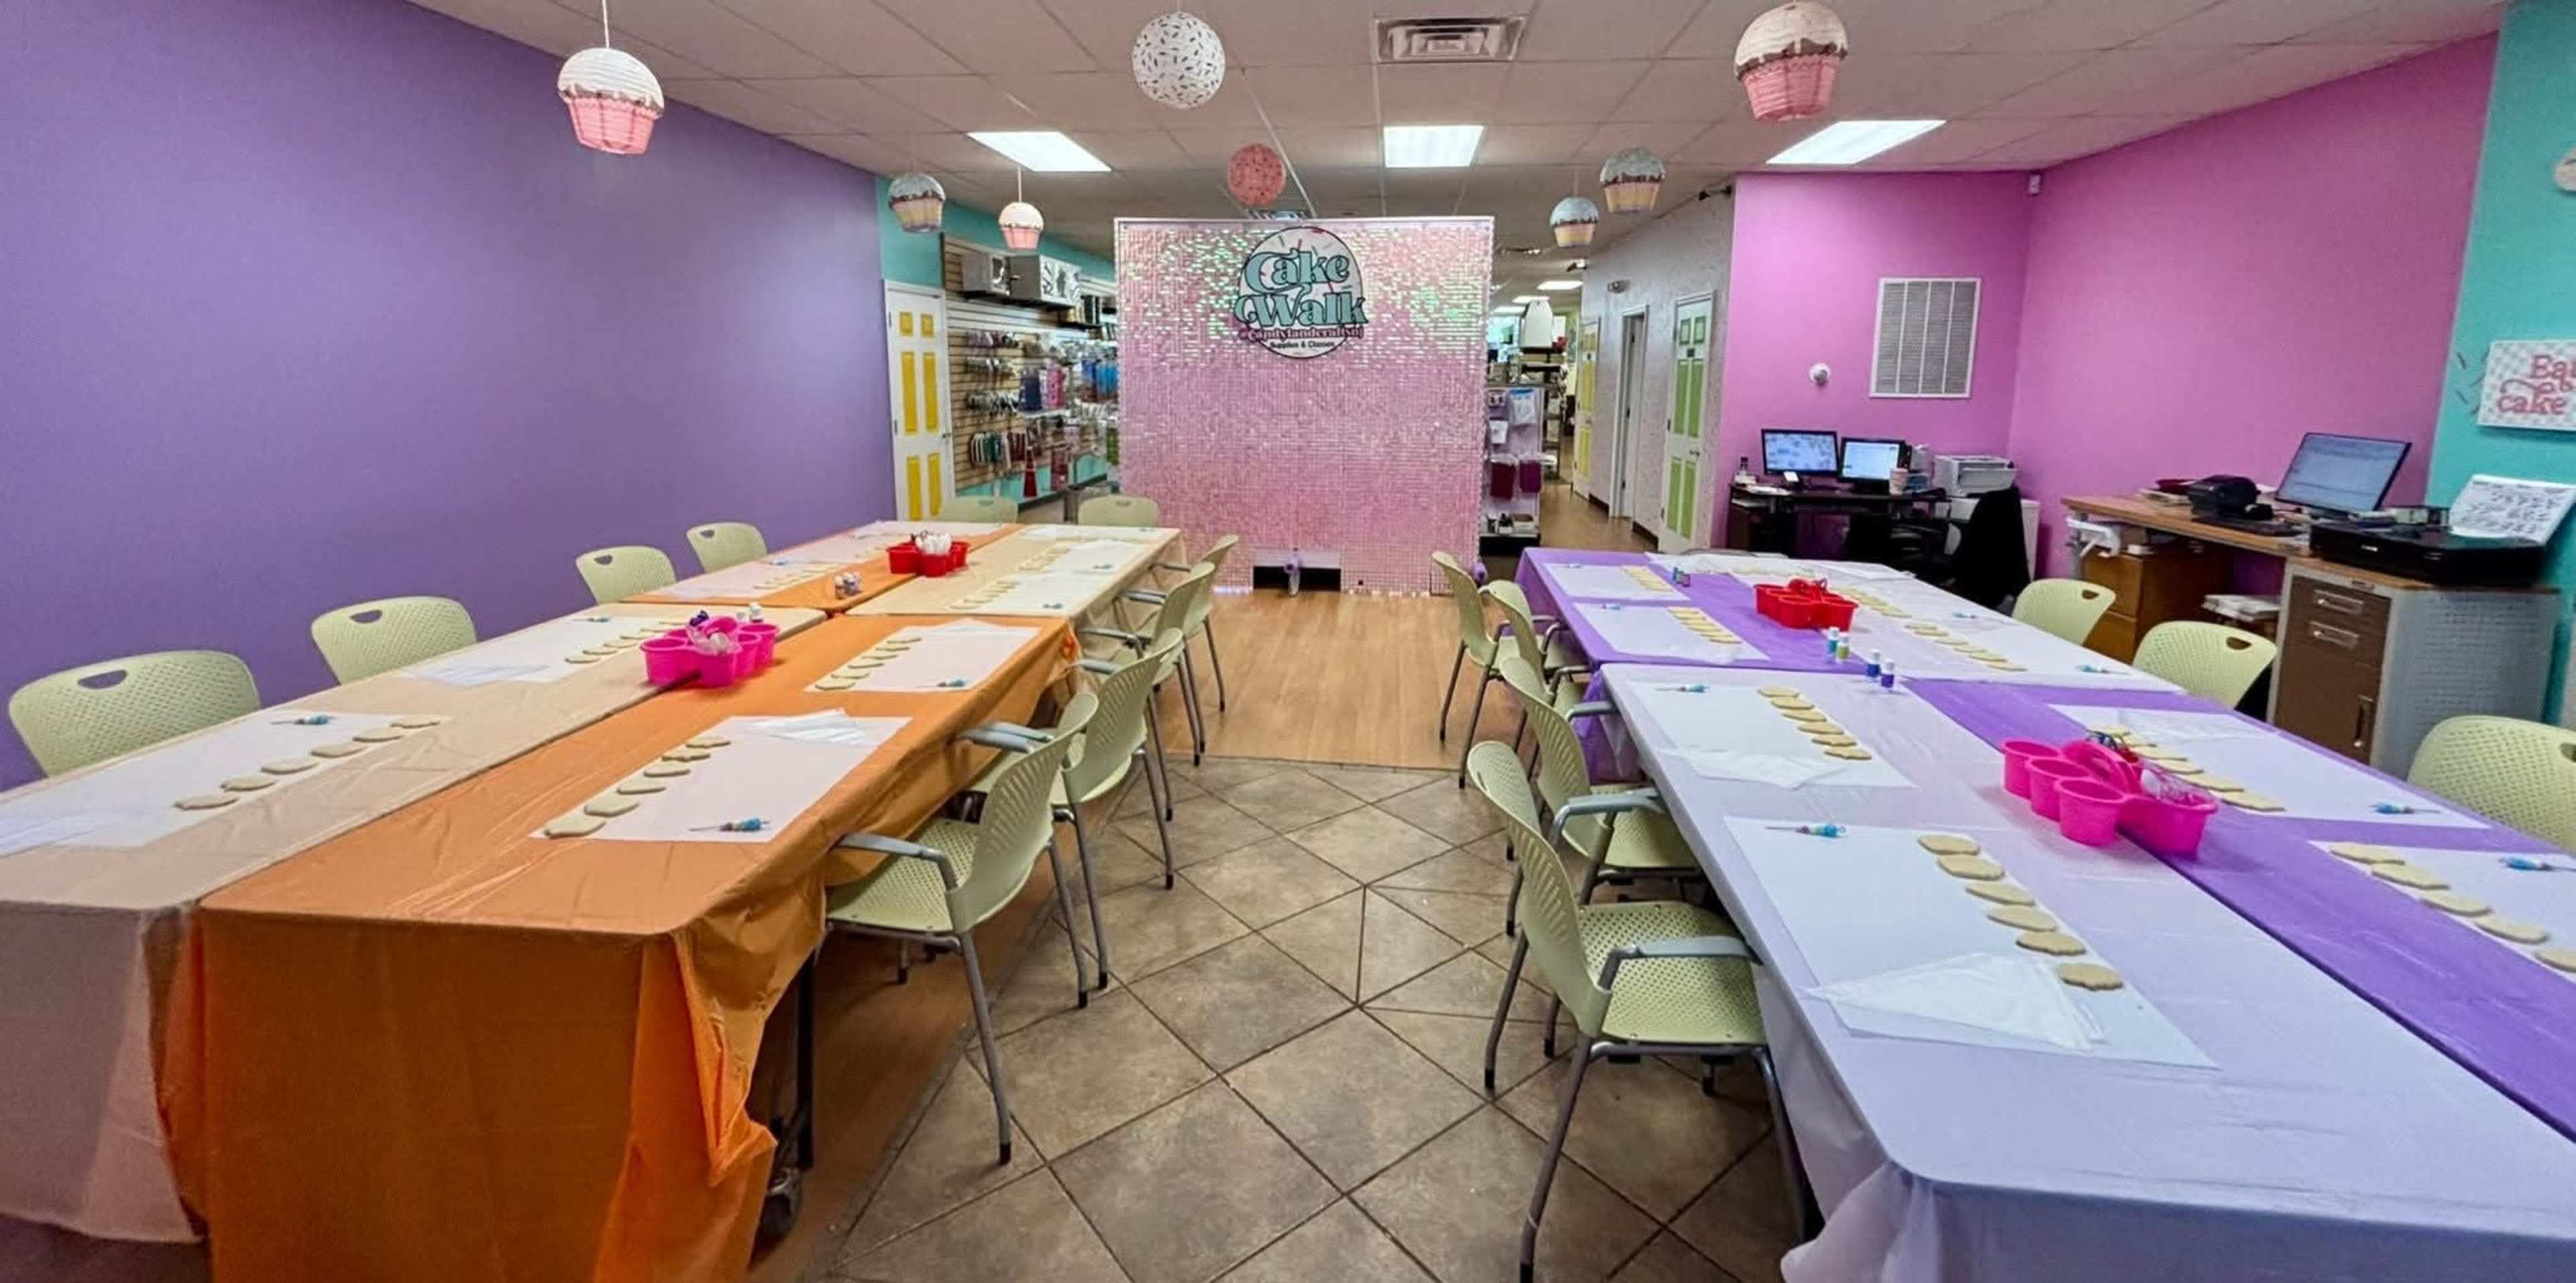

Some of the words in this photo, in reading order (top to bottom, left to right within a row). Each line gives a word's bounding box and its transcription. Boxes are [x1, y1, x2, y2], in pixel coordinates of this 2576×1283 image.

[1244, 248, 1350, 293] Cake
[1234, 284, 1368, 327] Walk
[1270, 341, 1298, 349] Supplies
